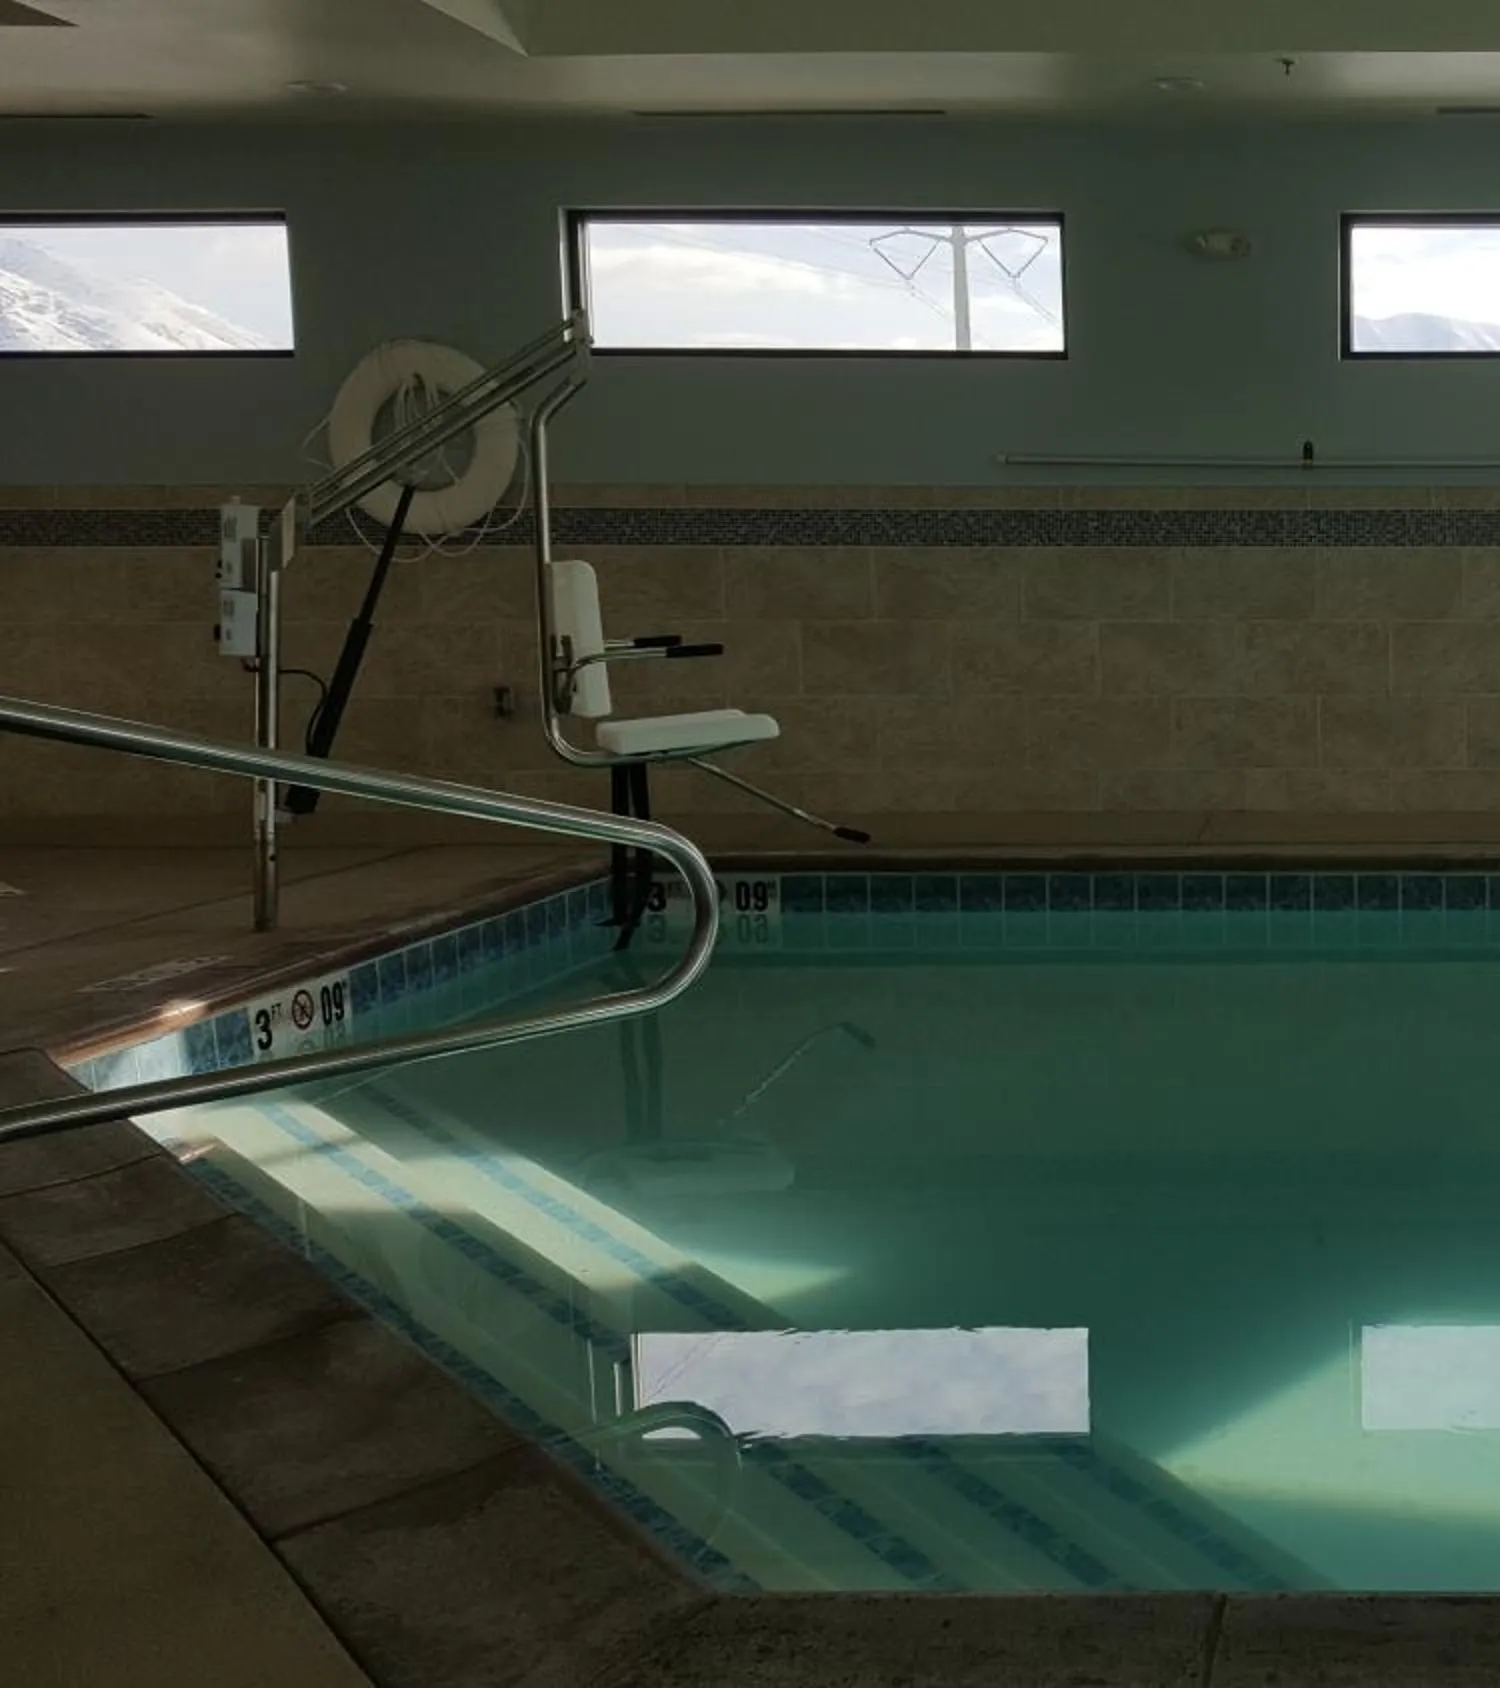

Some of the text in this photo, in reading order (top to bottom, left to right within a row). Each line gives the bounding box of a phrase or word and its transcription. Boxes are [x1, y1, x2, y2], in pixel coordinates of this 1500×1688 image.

[735, 880, 769, 912] 09
[255, 1008, 273, 1051] 3
[320, 981, 345, 1027] 09
